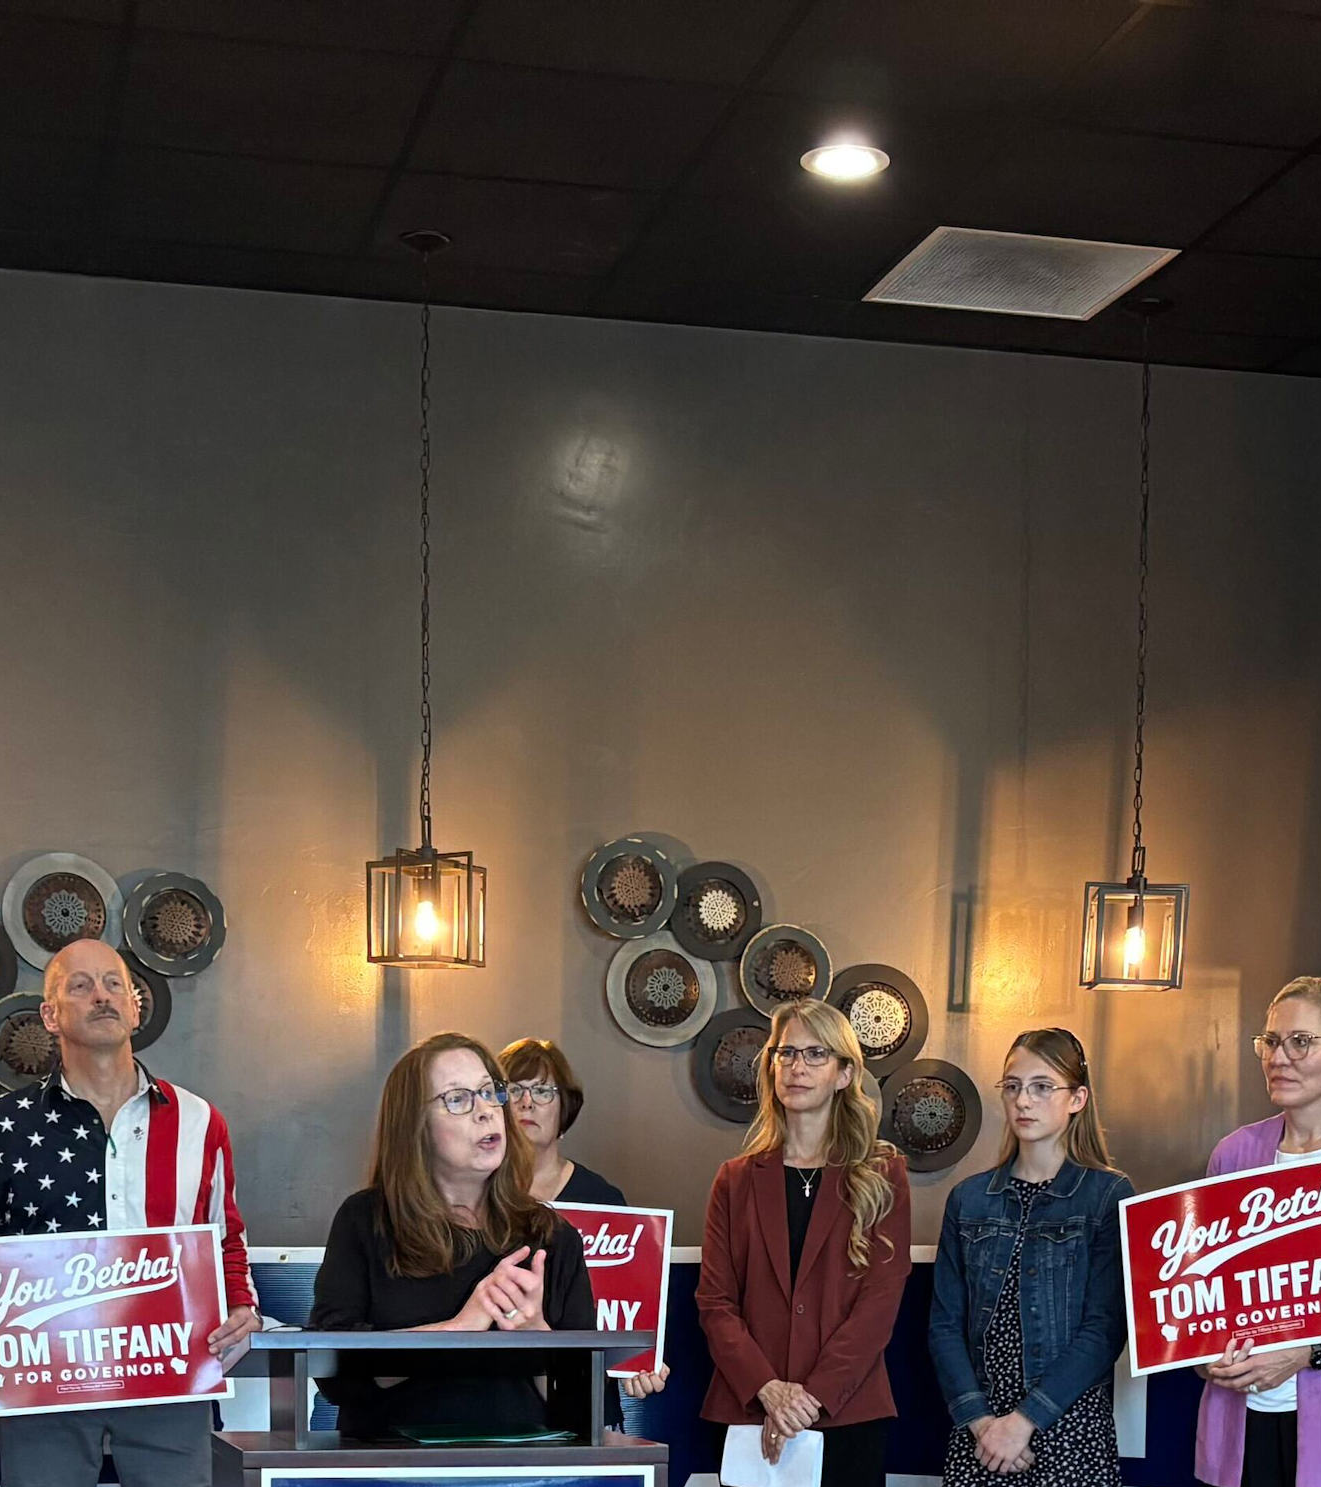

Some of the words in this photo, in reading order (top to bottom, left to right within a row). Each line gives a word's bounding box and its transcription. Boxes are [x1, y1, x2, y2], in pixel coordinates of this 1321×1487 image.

[578, 1213, 645, 1258] cha!
[1151, 1212, 1232, 1282] You
[62, 1245, 182, 1298] Betcha!
[1150, 1276, 1225, 1324] TOM
[59, 1322, 193, 1363] TIFFANY
[1188, 1317, 1227, 1336] FOR
[14, 1371, 52, 1385] FOR
[60, 1362, 165, 1382] GOVERNOR
